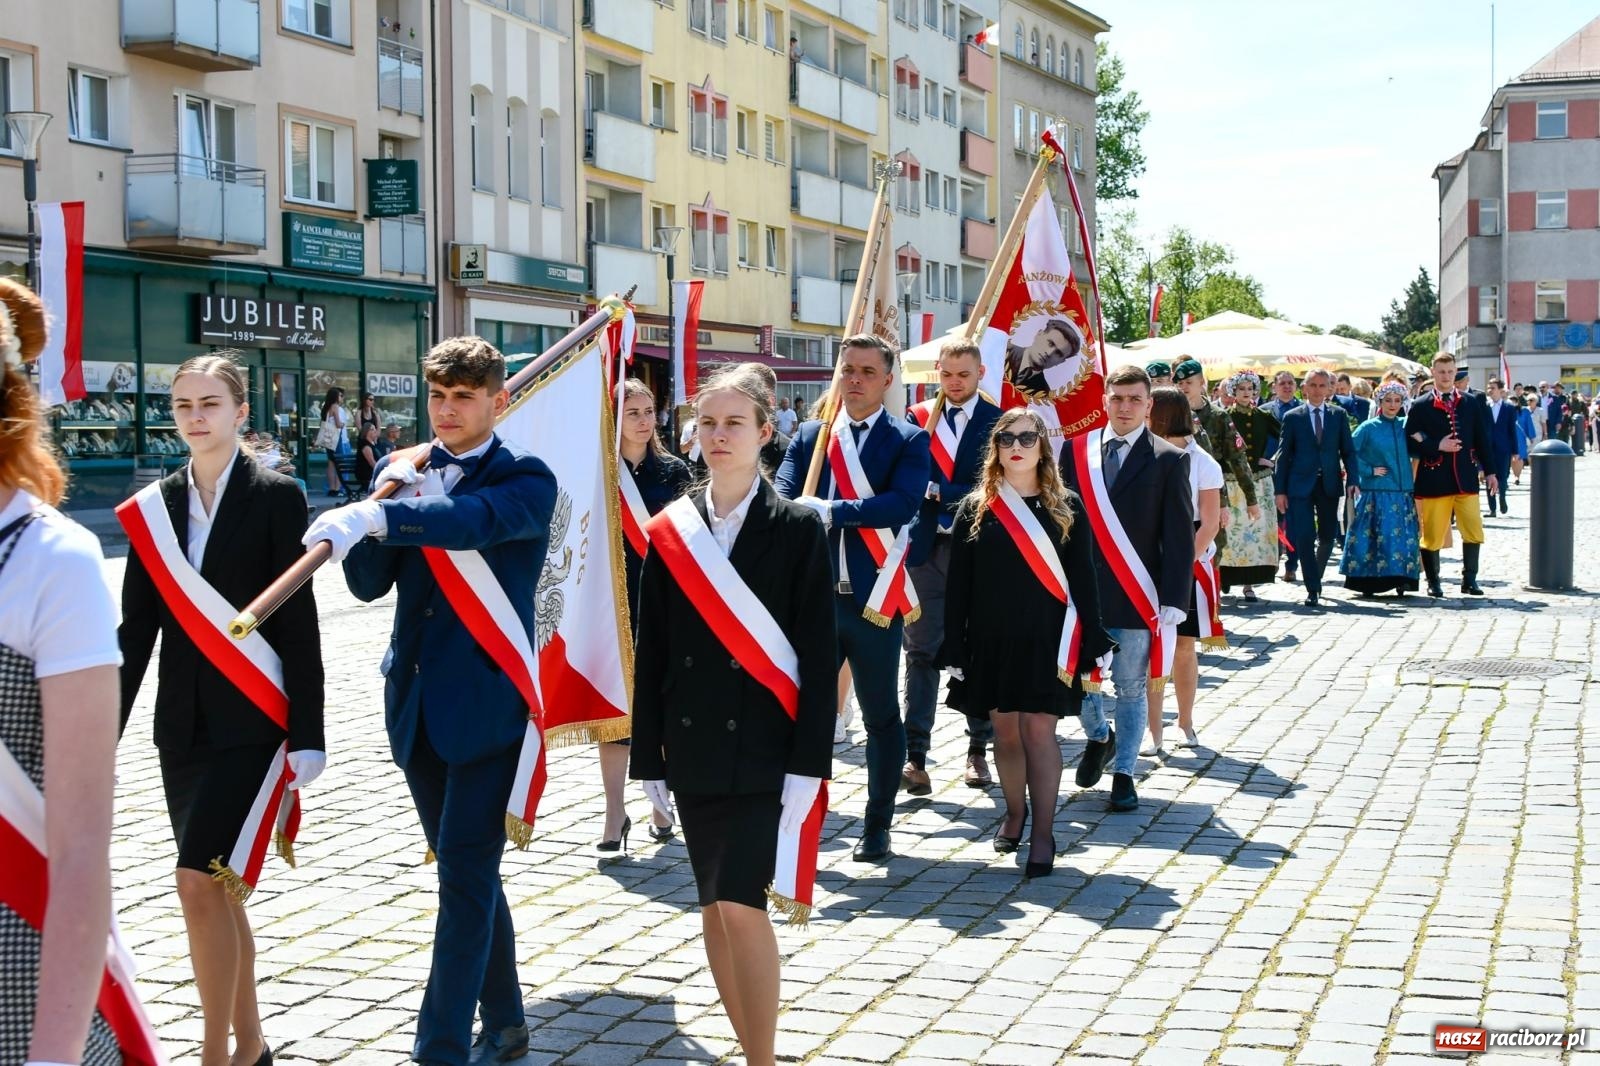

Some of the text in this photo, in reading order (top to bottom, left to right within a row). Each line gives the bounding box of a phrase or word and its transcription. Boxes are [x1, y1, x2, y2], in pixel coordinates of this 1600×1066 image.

[202, 295, 325, 331] JUBILER
[232, 331, 255, 341] 1989
[368, 375, 413, 395] CASIO
